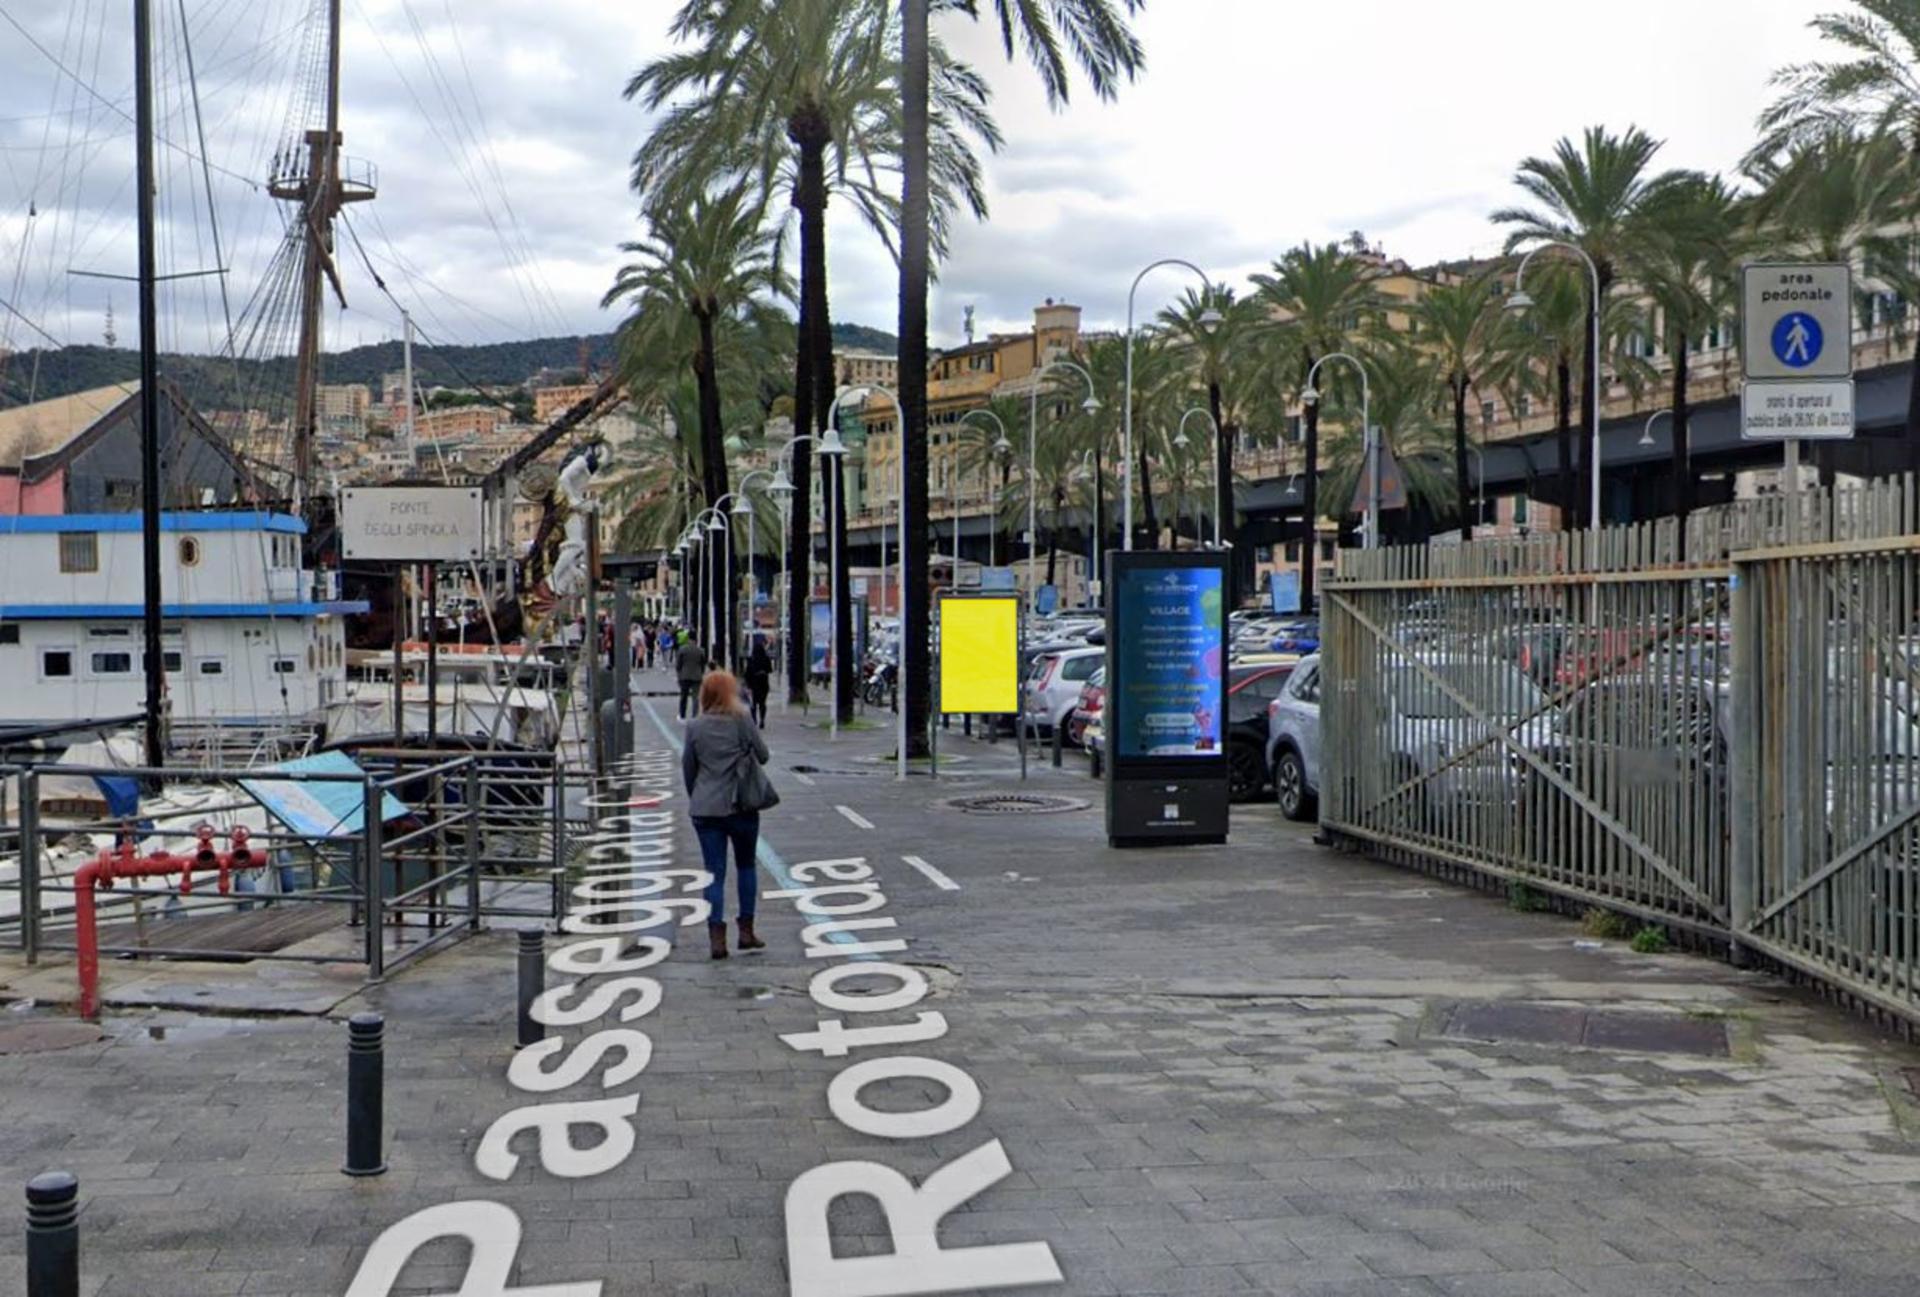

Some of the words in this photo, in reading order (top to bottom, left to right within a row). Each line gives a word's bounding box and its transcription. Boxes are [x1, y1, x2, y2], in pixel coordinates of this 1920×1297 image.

[1780, 273, 1813, 284] area
[1762, 288, 1832, 301] pedonale
[390, 501, 432, 515] PONTE
[364, 522, 401, 536] DEGLI
[406, 521, 459, 536] SPINOLA
[1149, 605, 1191, 616] VILLAGE
